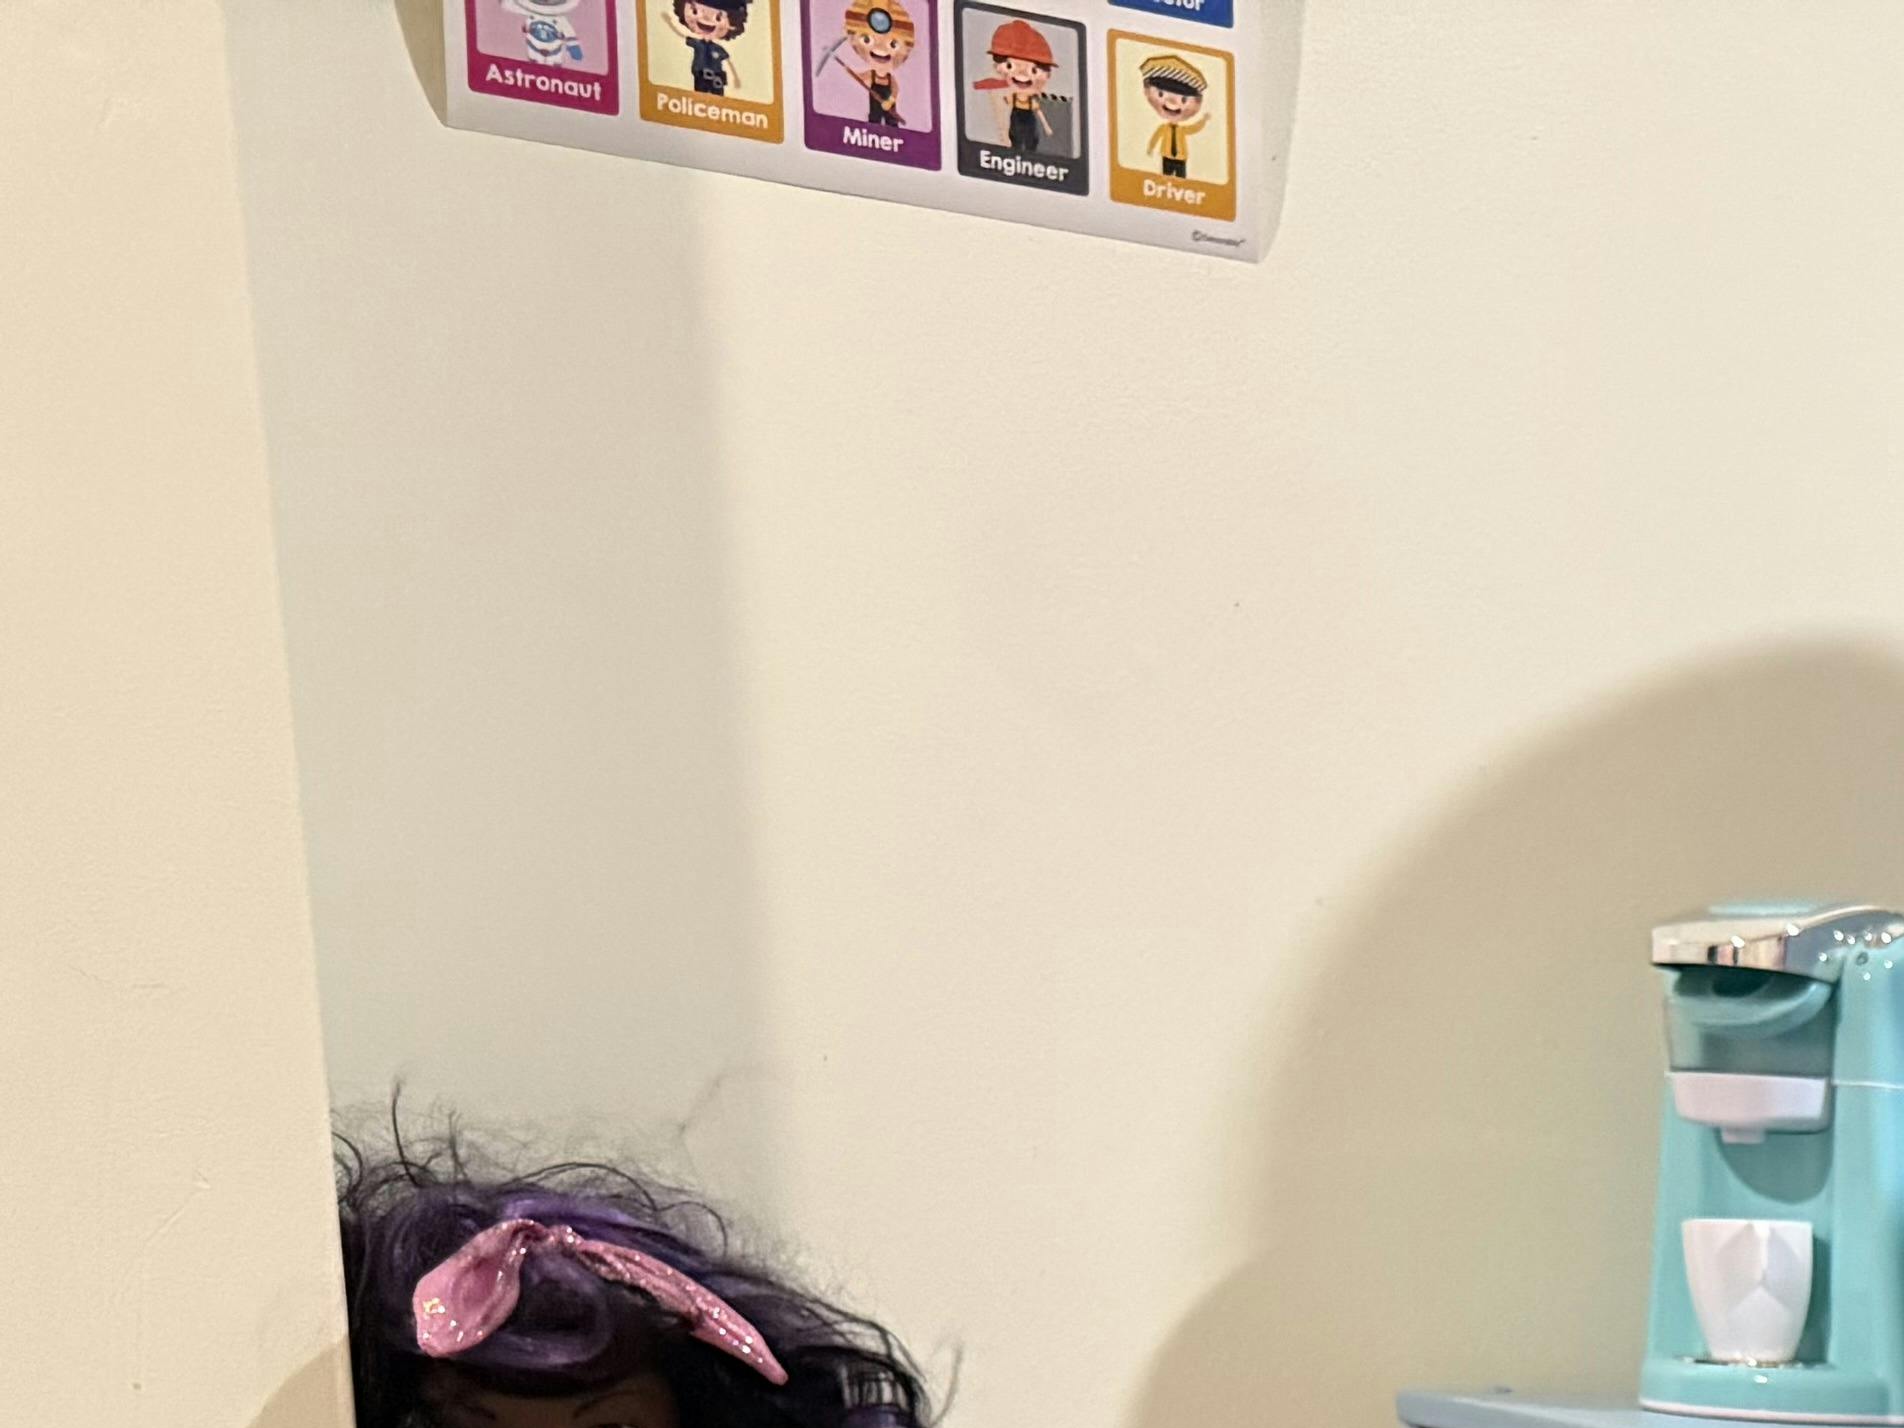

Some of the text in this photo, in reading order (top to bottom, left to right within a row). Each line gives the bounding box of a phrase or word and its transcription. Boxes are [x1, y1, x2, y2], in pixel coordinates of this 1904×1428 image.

[486, 64, 601, 100] Astronaut
[656, 93, 768, 129] Policeman
[843, 127, 904, 152] Miner
[979, 150, 1069, 182] Engineer
[1143, 179, 1206, 205] Driver
